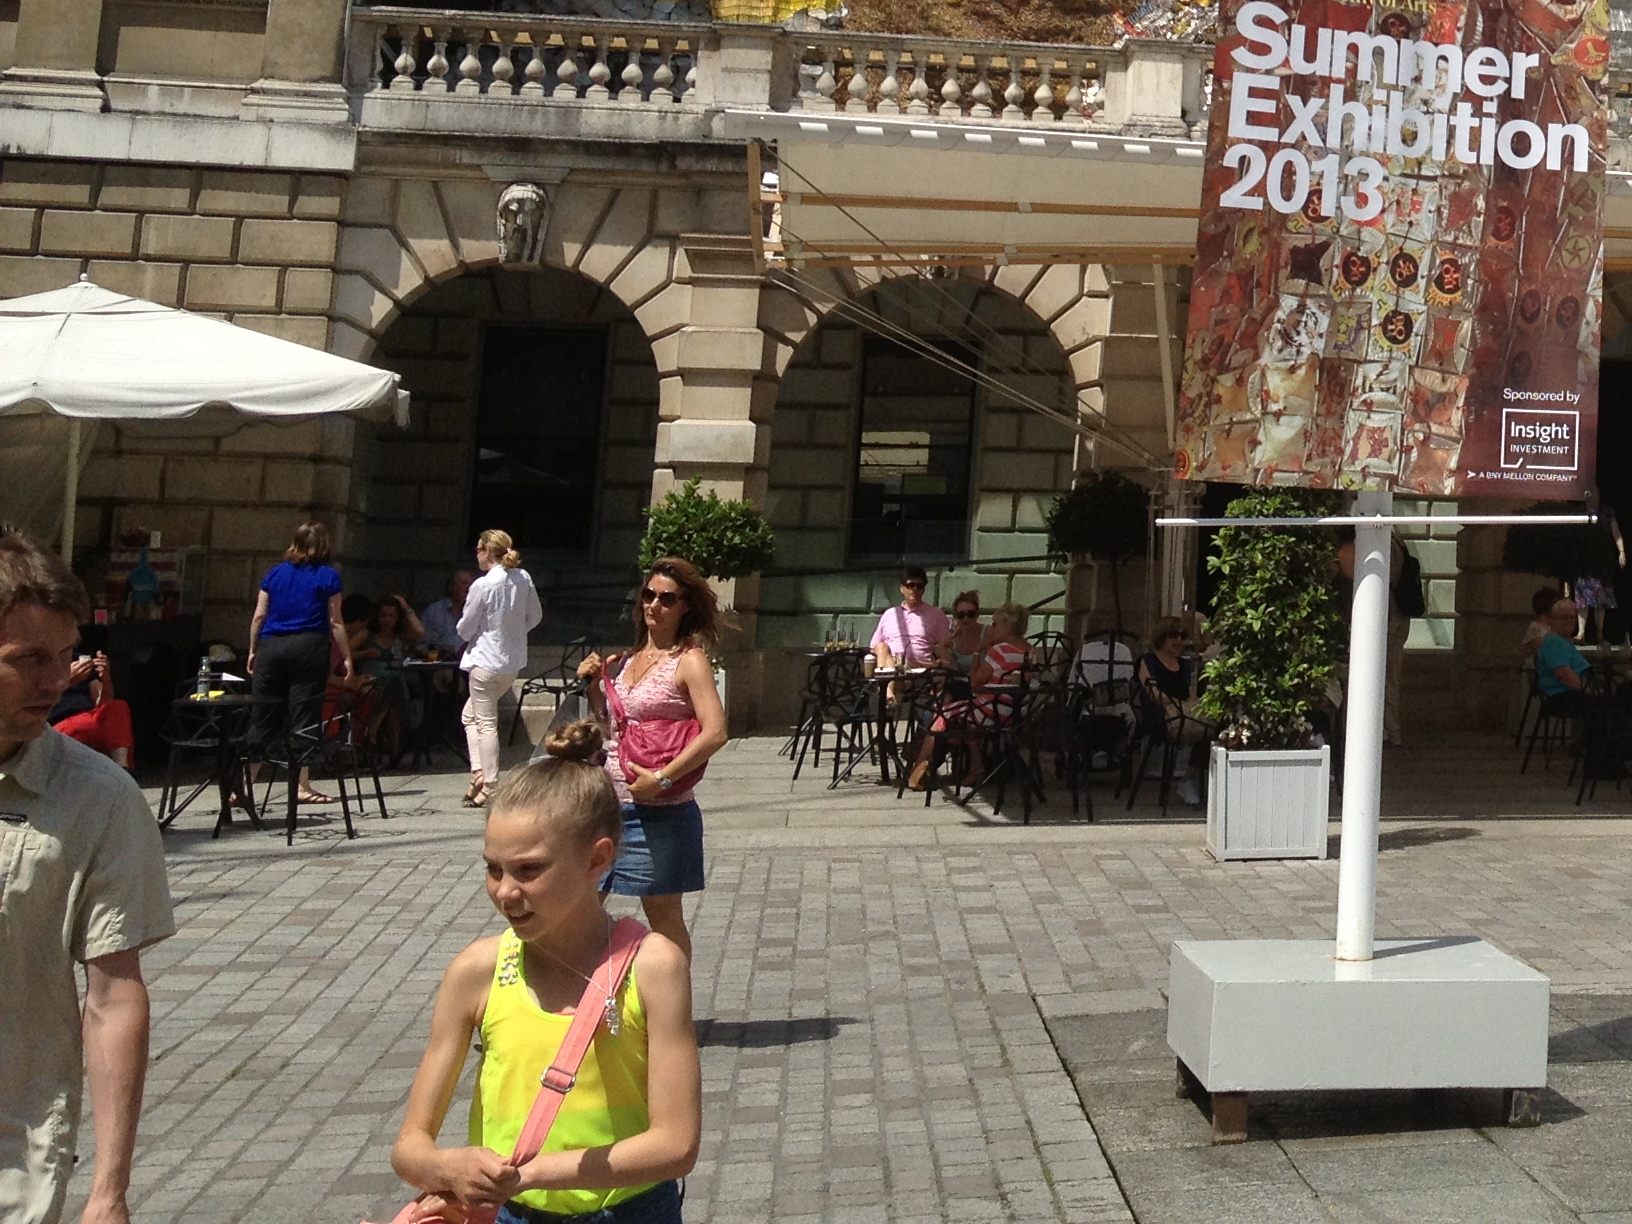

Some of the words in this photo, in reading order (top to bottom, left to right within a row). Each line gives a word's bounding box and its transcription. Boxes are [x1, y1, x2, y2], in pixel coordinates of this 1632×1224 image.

[1231, 1, 1540, 100] Summer
[1228, 72, 1590, 173] Exhibition
[1219, 143, 1385, 221] 2013
[1503, 387, 1564, 402] Sponsored
[1566, 391, 1580, 404] by
[1510, 421, 1570, 443] Insight
[1510, 444, 1570, 455] INVESTMENT
[1479, 471, 1485, 479] A
[1502, 472, 1534, 481] MELLON
